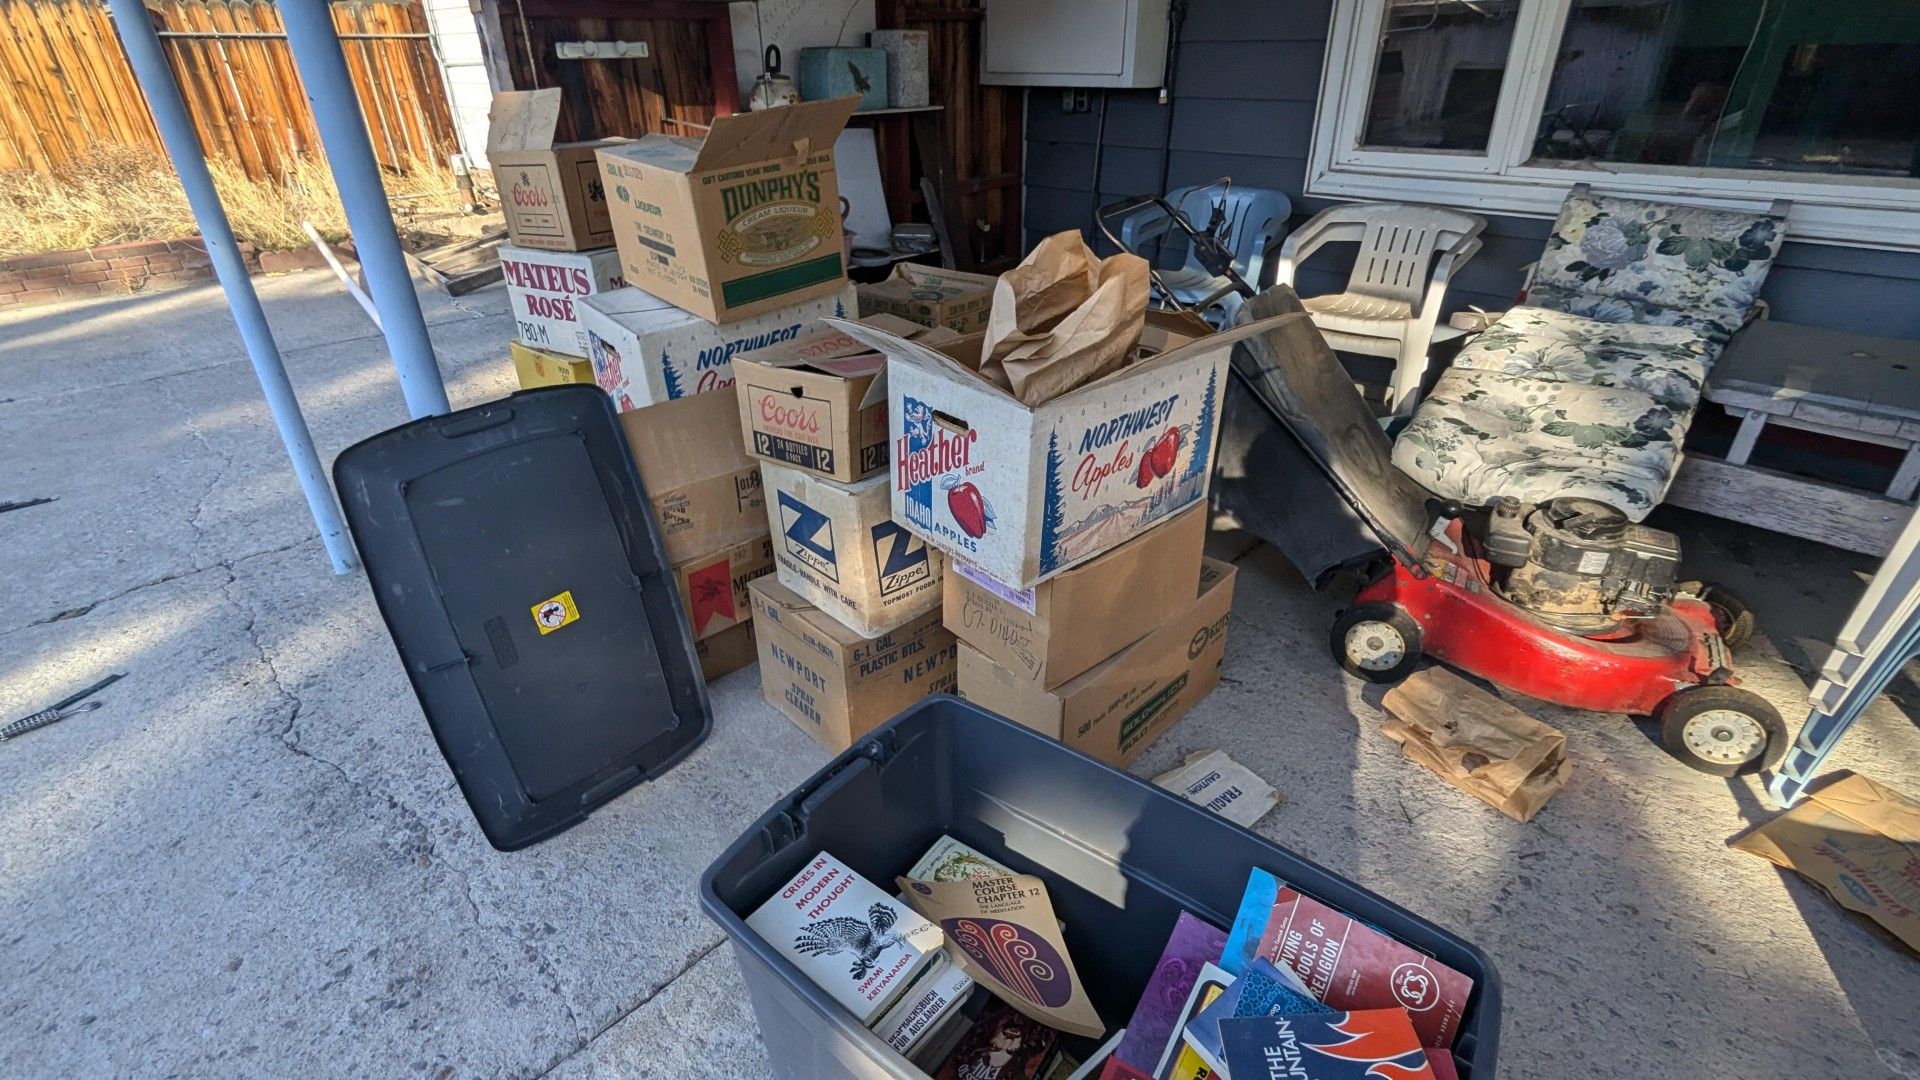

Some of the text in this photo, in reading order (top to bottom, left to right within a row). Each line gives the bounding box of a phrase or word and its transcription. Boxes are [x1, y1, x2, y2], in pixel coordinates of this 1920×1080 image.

[512, 183, 548, 207] Coors
[720, 169, 820, 225] DUNPHY'S
[742, 205, 809, 227] CREAM LIQUEUR
[501, 260, 591, 296] MATEUS
[525, 294, 576, 322] ROSÉ
[518, 320, 549, 344] 780-M
[759, 394, 820, 433] Coors
[1079, 394, 1179, 455] NORTHWEST
[756, 433, 770, 455] 12
[816, 448, 831, 471] 12
[864, 447, 876, 471] 12
[896, 427, 977, 492] Heather
[965, 461, 985, 476] brand
[1071, 440, 1134, 501] Apples
[906, 495, 931, 528] IDAHO
[934, 522, 977, 553] APPLES
[823, 584, 839, 600] WITH
[840, 595, 858, 611] CARE
[883, 589, 914, 606] TOPMOST
[915, 580, 936, 593] FOODS
[875, 635, 896, 652] GAL
[771, 642, 827, 693] NEWPORT
[860, 650, 898, 677] PLASTIC
[904, 643, 957, 684] NEWPO
[785, 690, 821, 725] CLEANER
[792, 682, 814, 706] SPRAY
[1204, 785, 1243, 812] FRAGIL
[782, 858, 828, 900] CRISES IN
[795, 867, 840, 910] MODERN
[972, 877, 1015, 890] MASTER
[974, 883, 1019, 897] COURSE
[807, 873, 856, 920] THOUGHT
[976, 888, 1040, 904] CHAPTER 12
[990, 900, 1021, 909] LANGUAGE
[990, 904, 1026, 914] MEDITATION
[1309, 918, 1326, 938] OF
[1281, 929, 1304, 967] IVING
[858, 966, 885, 994] SWAMI
[866, 953, 912, 1001] KRIYANANDA
[1309, 938, 1340, 999] RELIGION
[909, 996, 947, 1037] AUSLÄNDER
[1264, 1046, 1288, 1080] THE
